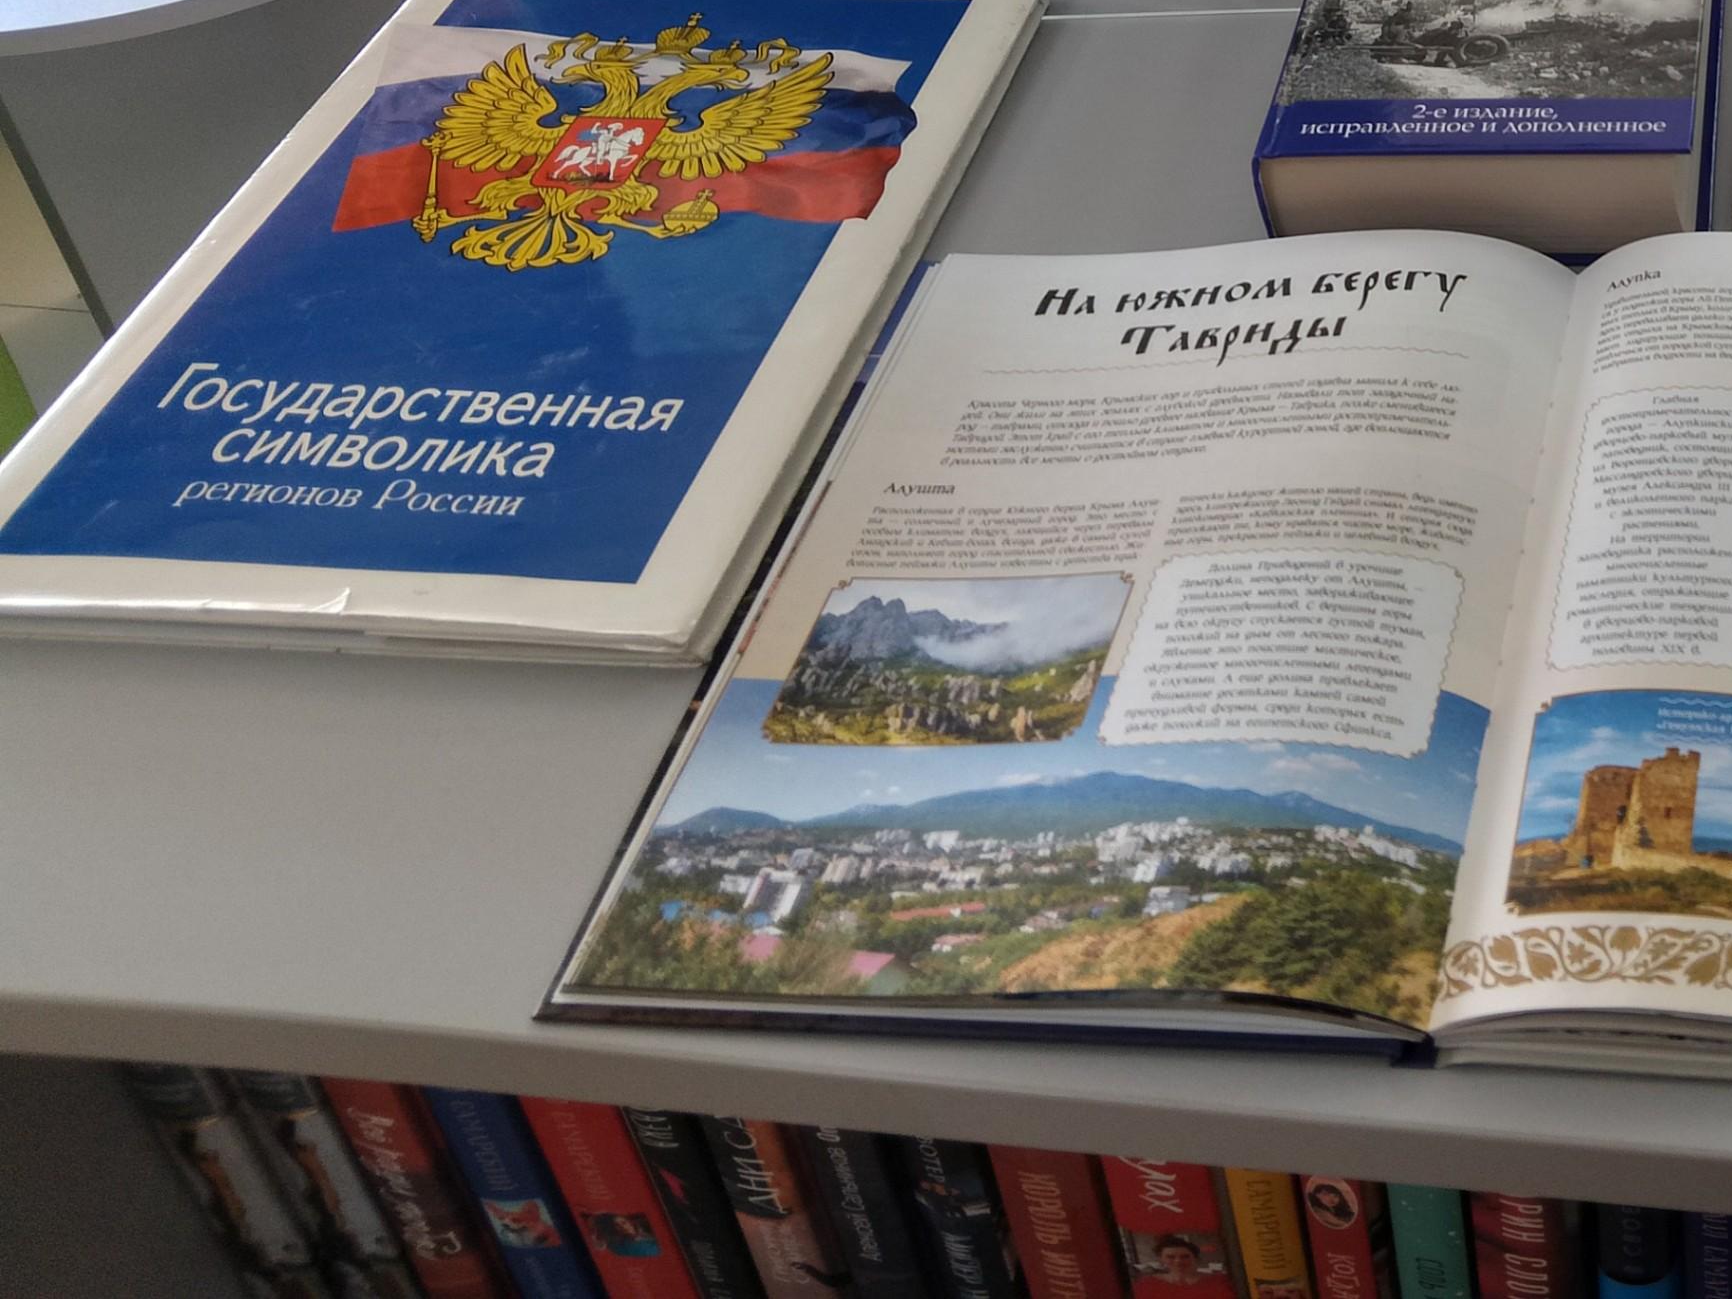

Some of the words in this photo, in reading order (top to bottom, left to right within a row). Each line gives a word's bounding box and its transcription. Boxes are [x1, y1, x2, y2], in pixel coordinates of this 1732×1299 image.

[1412, 105, 1447, 120] 2-е
[1453, 105, 1559, 122] издание,
[1300, 120, 1476, 138] исправленное
[1481, 121, 1497, 134] и
[1502, 119, 1668, 137] дополненное
[1606, 267, 1663, 292] Алупка
[157, 362, 686, 434] Государственная
[211, 427, 557, 479] символика
[172, 479, 364, 509] регионов
[373, 478, 527, 516] России
[883, 481, 956, 498] Алушта
